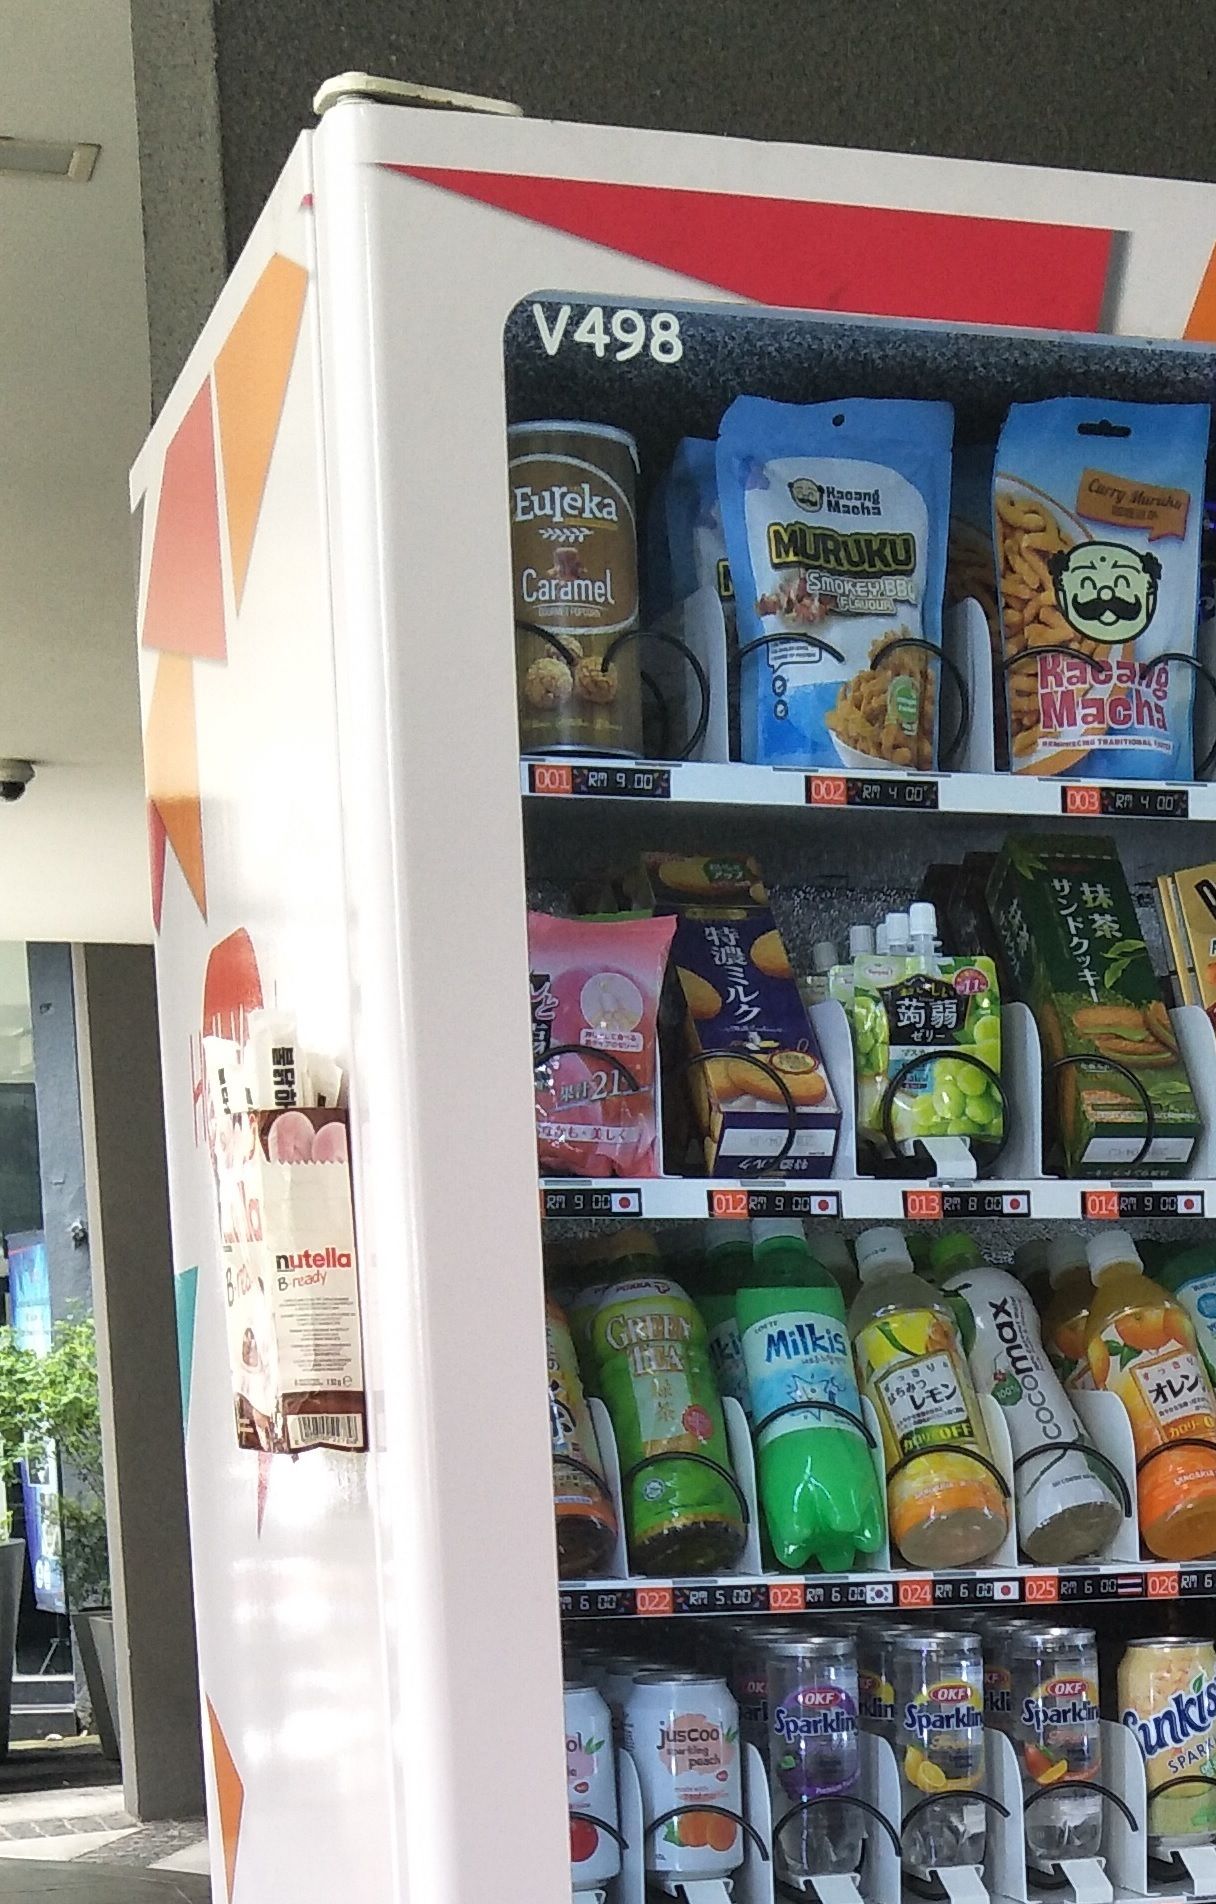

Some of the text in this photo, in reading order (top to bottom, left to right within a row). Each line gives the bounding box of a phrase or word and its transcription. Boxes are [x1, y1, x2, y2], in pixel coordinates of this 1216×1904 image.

[532, 304, 683, 363] V498
[514, 483, 618, 522] Eureka
[770, 524, 914, 572] MURUKU
[523, 568, 615, 605] Caramel
[1038, 655, 1169, 701] Kacang
[1040, 690, 1168, 732] Macha
[536, 769, 654, 791] 001 RM 9.00
[812, 781, 844, 802] 002
[1068, 790, 1098, 812] 003
[1080, 882, 1122, 939] 抹茶
[1051, 879, 1100, 1003] サンドクッキー
[704, 926, 762, 1024] 特濃ミルク
[896, 998, 958, 1029] 蒟蒻
[911, 1030, 946, 1042] ゼリー
[591, 1069, 620, 1100] 21
[714, 1194, 747, 1213] 012
[908, 1194, 939, 1214] 013
[1087, 1195, 1118, 1214] 014
[276, 1247, 351, 1270] nutella
[605, 1314, 691, 1350] GREEN
[765, 1323, 847, 1363] Milkis
[632, 1346, 685, 1377] TEA
[988, 1297, 1062, 1440] cocomax
[909, 1383, 957, 1410] レモン
[900, 1583, 931, 1604] 024
[1026, 1579, 1057, 1600] 025
[1149, 1574, 1178, 1595] 026
[637, 1592, 669, 1612] 022
[689, 1590, 709, 1605] RM
[770, 1588, 801, 1609] 023
[806, 1588, 824, 1601] RM
[805, 1692, 836, 1706] OKF
[938, 1688, 966, 1700] OKF
[1055, 1682, 1082, 1695] OKF
[905, 1703, 983, 1738] Sparklin
[1021, 1697, 1099, 1732] Sparklin
[688, 1755, 721, 1770] peach
